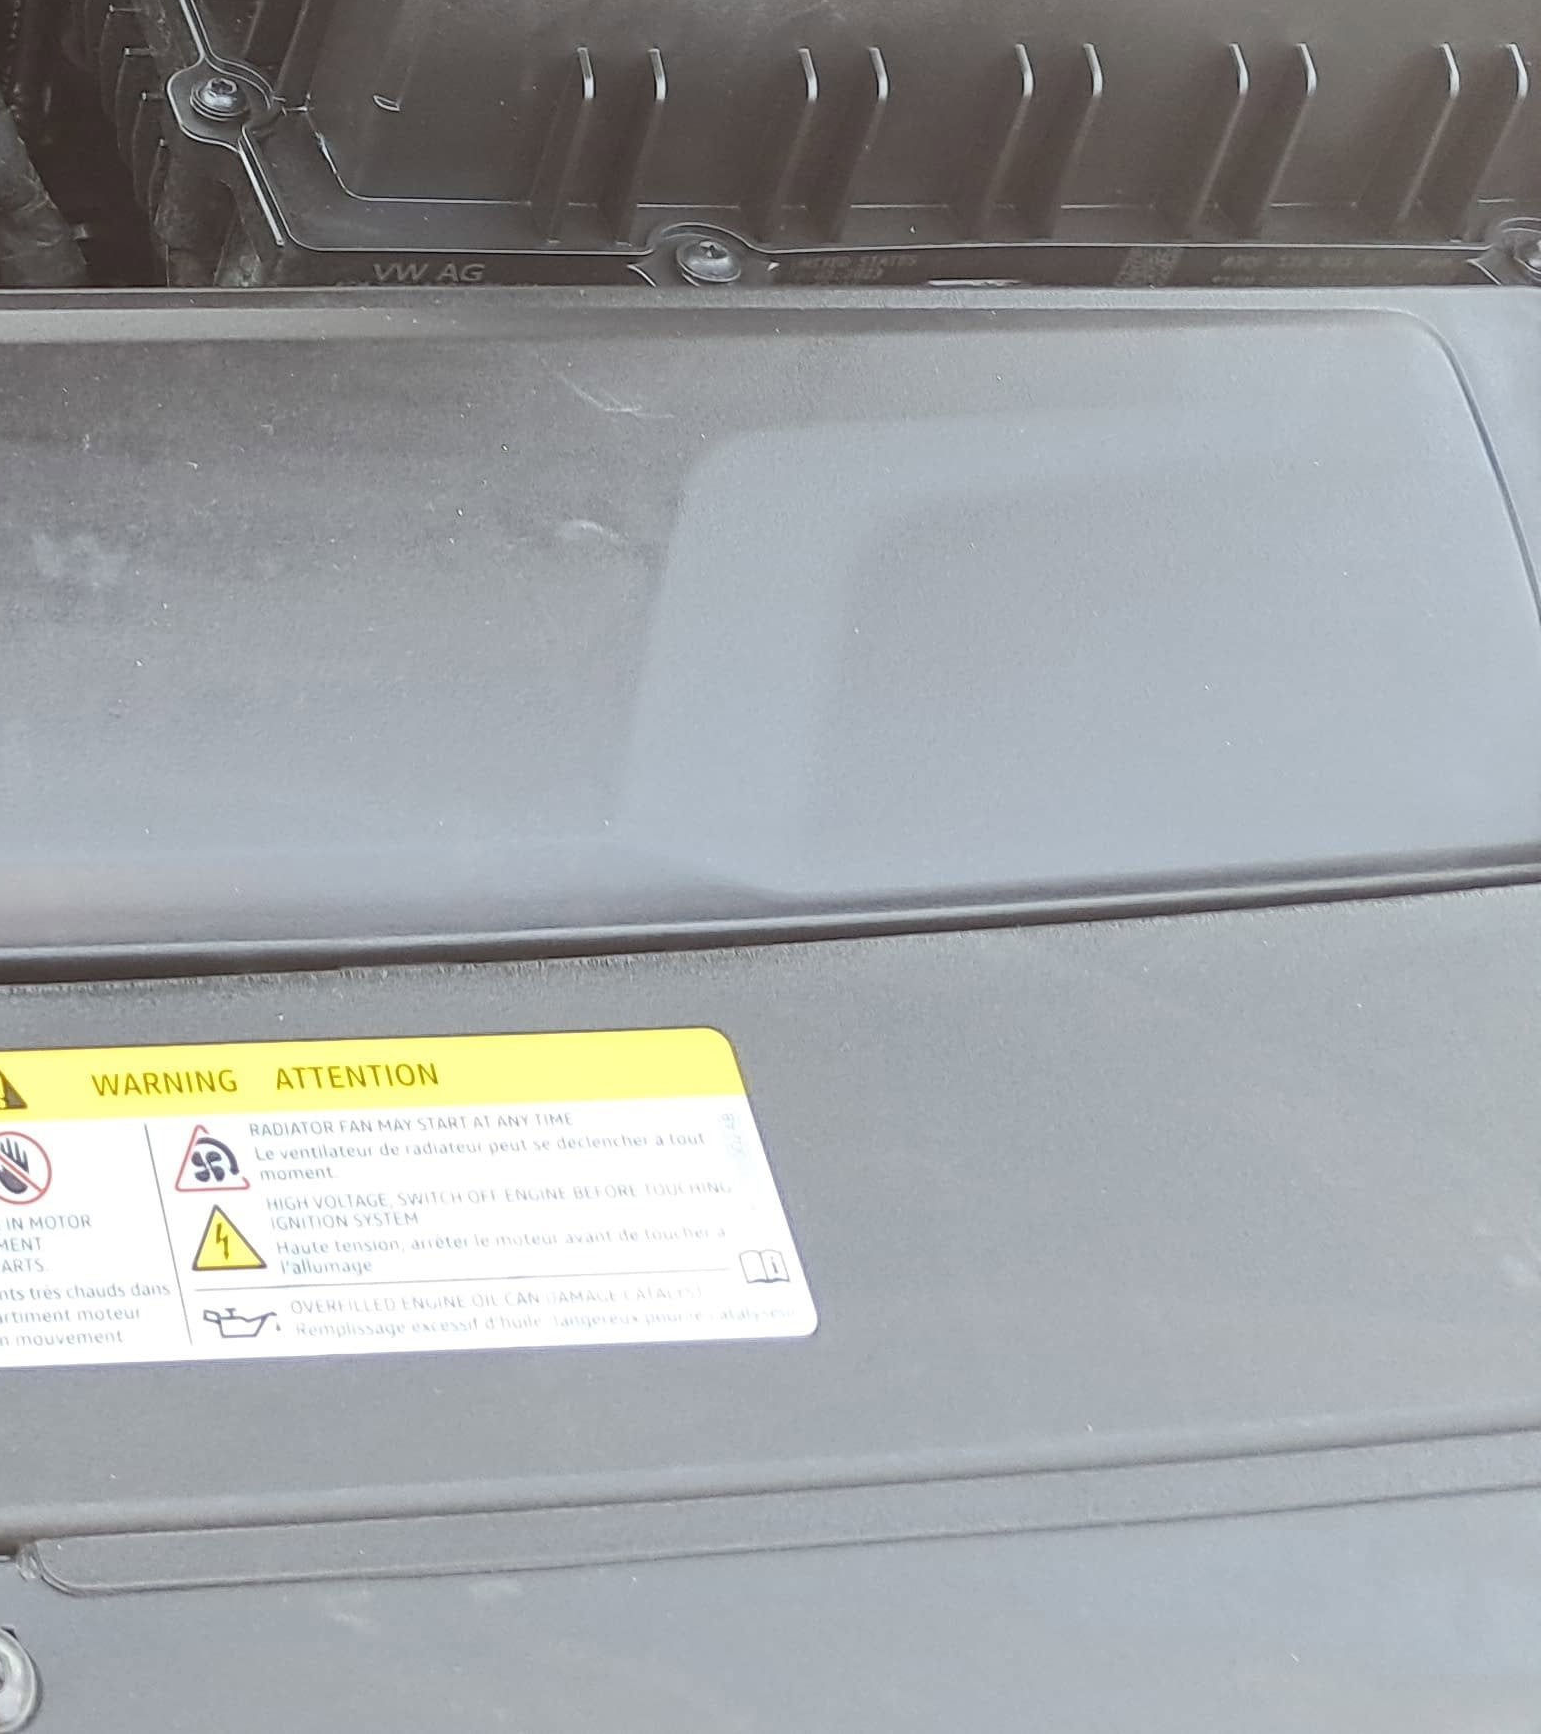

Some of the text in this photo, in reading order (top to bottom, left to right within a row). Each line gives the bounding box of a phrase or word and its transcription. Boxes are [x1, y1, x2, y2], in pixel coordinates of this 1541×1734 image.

[372, 262, 486, 282] VW AG
[90, 1069, 240, 1098] WARNING
[274, 1062, 440, 1091] ATTENTION
[249, 1112, 574, 1137] RADIATOR FAN MAY START AT ANY TIME
[254, 1146, 276, 1162] Le
[279, 1143, 374, 1161] ventilateur
[379, 1142, 400, 1157] de
[488, 1137, 528, 1156] peut
[532, 1140, 551, 1153] se
[668, 1131, 707, 1147] tout
[266, 1196, 308, 1212] HIGH
[6, 1216, 25, 1232] IN
[29, 1214, 93, 1231] MOTOR
[271, 1211, 421, 1231] IGNITION SYSTEM
[275, 1240, 330, 1256] Haute
[65, 1282, 126, 1299] chauds
[130, 1281, 172, 1297] dans
[290, 1296, 397, 1315] OVERFILLED
[503, 1289, 541, 1307] CAN
[77, 1306, 142, 1322] moteur
[17, 1329, 125, 1347] mouvement
